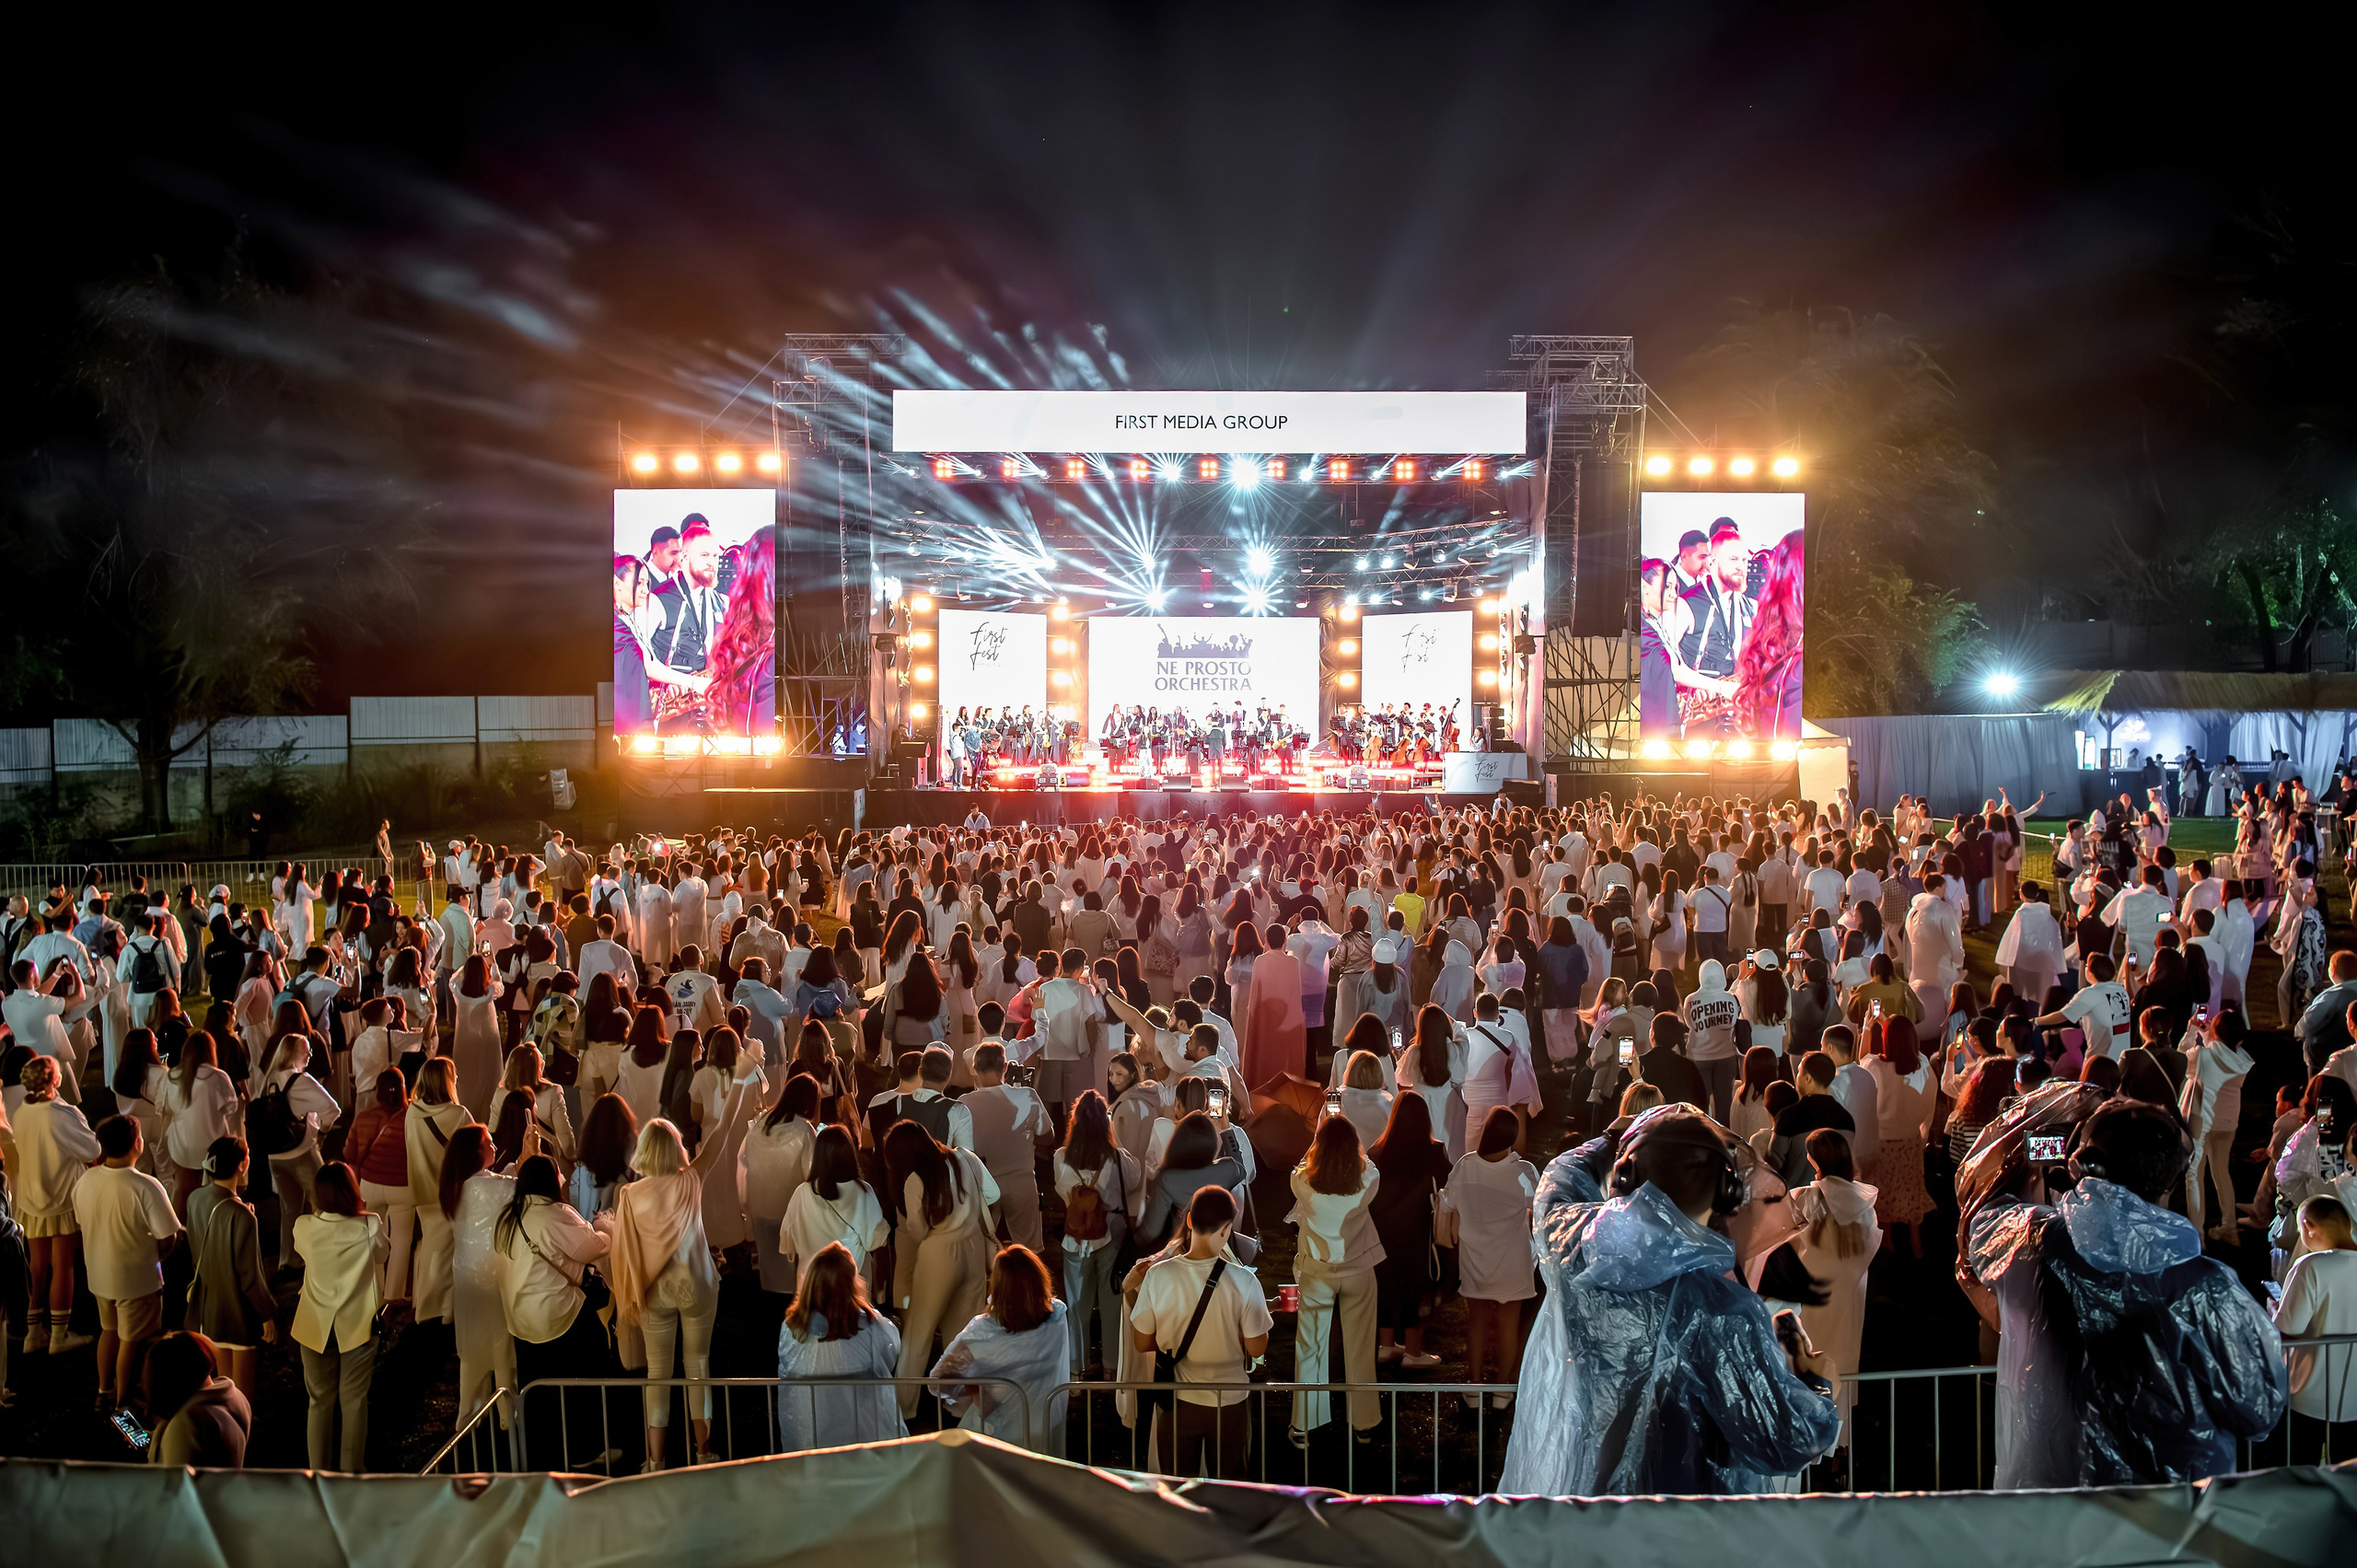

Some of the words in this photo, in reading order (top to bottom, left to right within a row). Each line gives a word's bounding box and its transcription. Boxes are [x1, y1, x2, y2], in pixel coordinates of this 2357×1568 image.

[1115, 414, 1158, 429] FIRST
[1163, 414, 1217, 429] MEDIA
[1223, 414, 1288, 430] GROUP
[1156, 661, 1178, 675] NE
[1185, 661, 1252, 676] PROSTO
[1155, 677, 1253, 691] ORCHESTRA
[1690, 1000, 1735, 1022] OPENING
[1694, 1014, 1735, 1033] JOURNEY
